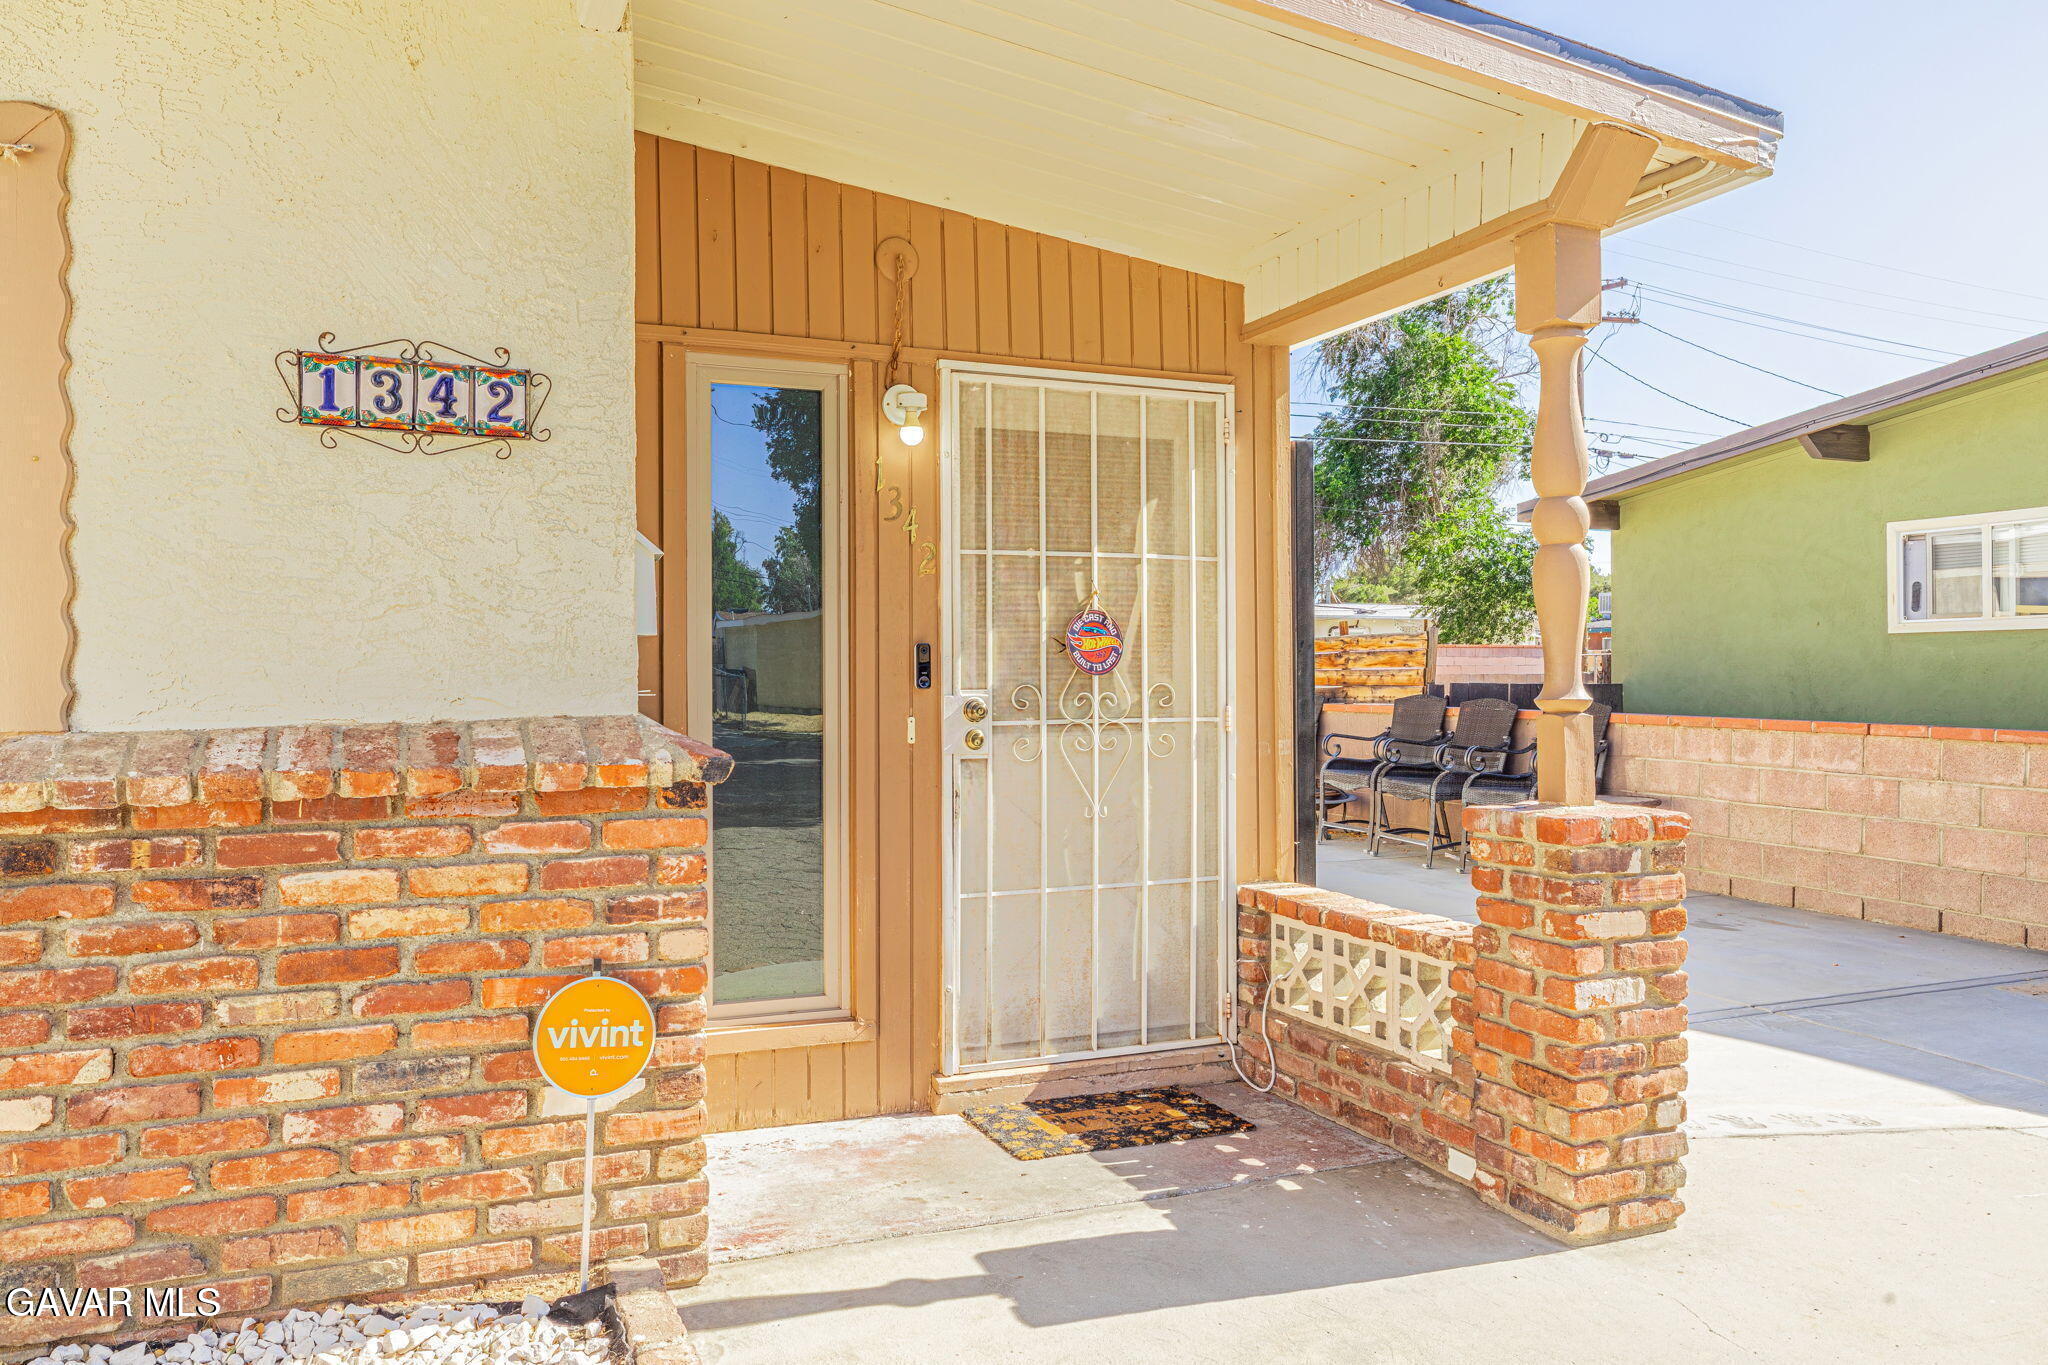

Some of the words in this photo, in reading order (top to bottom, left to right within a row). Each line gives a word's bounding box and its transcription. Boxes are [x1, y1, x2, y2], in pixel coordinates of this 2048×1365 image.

[317, 366, 514, 424] 1342
[874, 455, 937, 578] 1342
[1103, 619, 1117, 636] AND
[1072, 651, 1092, 670] BUILT
[1092, 663, 1103, 671] TO
[1103, 651, 1118, 667] LAST
[547, 1018, 645, 1049] vivint
